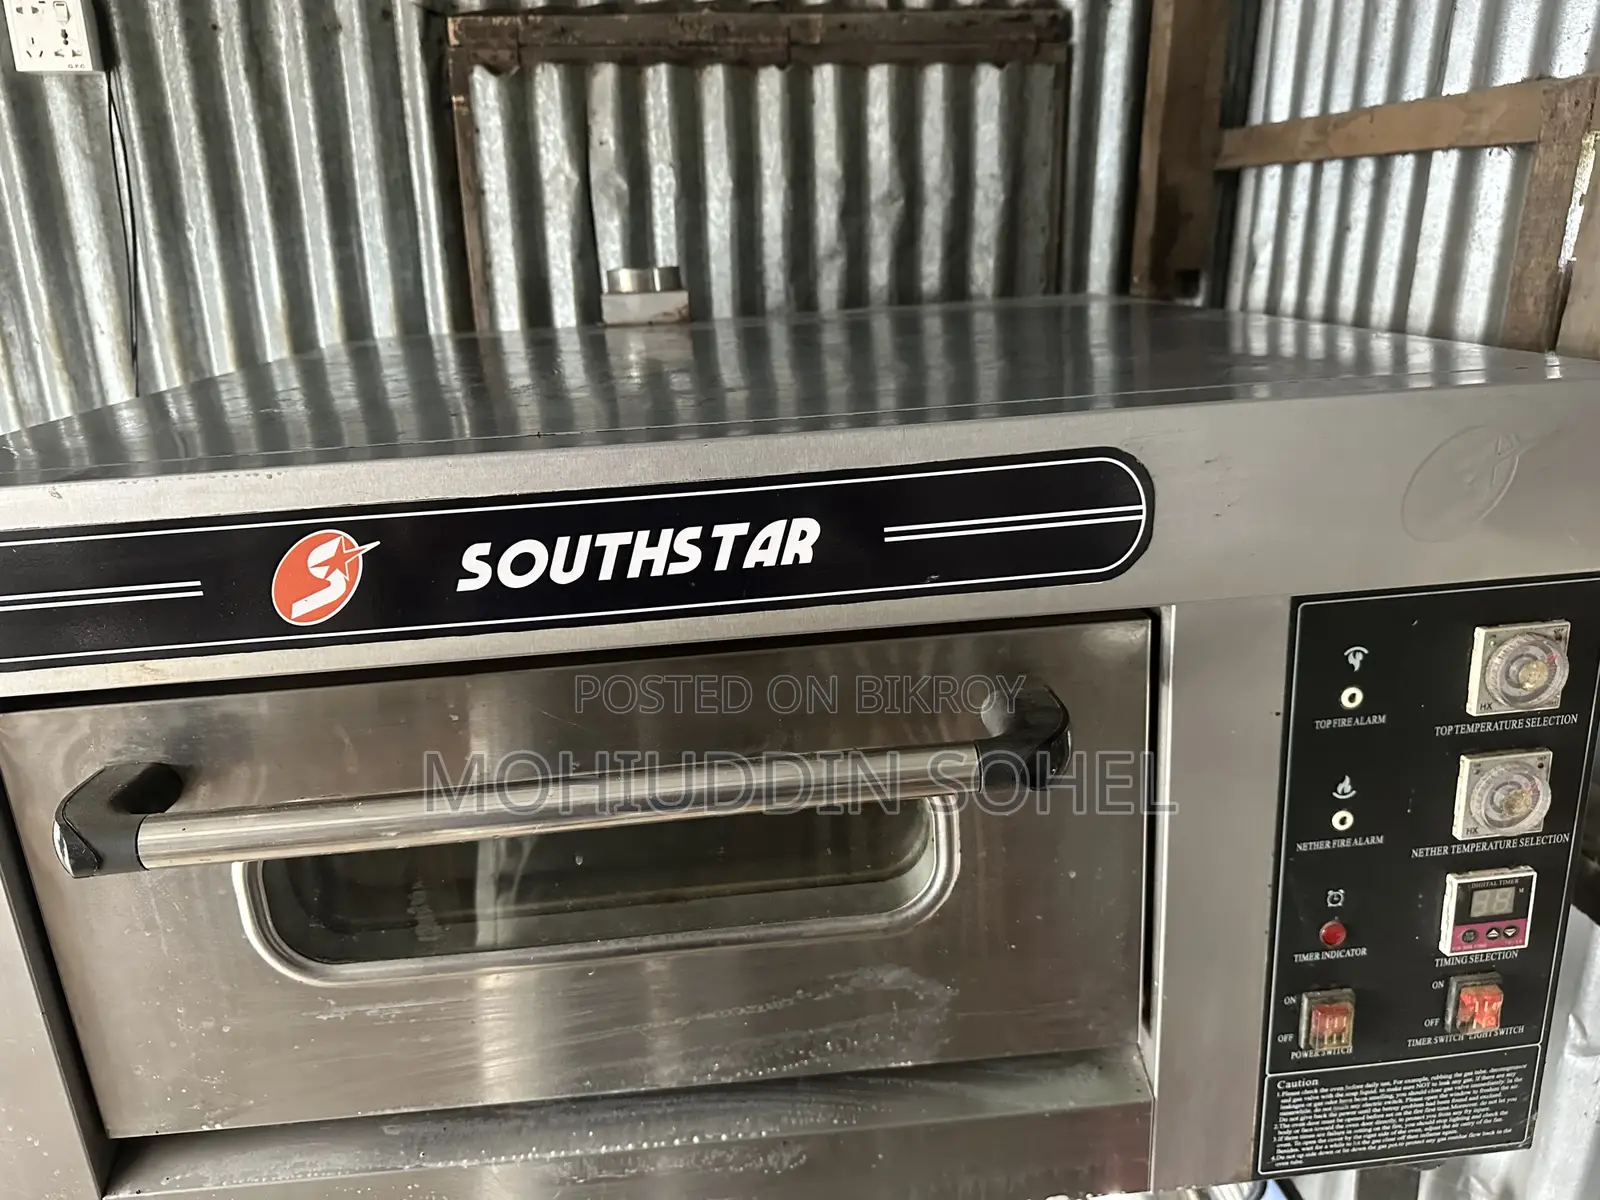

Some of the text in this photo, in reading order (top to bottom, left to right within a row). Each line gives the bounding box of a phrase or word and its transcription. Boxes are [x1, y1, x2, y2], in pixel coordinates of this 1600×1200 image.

[456, 517, 821, 592] SOUTHSTAR
[1480, 702, 1493, 710] HX
[1314, 714, 1386, 730] TOP FIRE ALARM
[1434, 714, 1578, 736] TOP TEMPERATURE SELECTION
[1296, 834, 1384, 852] NETHER FIRE ALARM
[1411, 832, 1570, 858] NETHER TEMPERATURE SELECTION
[1294, 948, 1367, 962] TIMER INDICATOR
[1434, 950, 1520, 968] TIMING SELECTION
[1432, 980, 1444, 990] ON
[1284, 996, 1297, 1004] ON
[1424, 1018, 1440, 1027] OFF
[1494, 1025, 1525, 1036] SWITCH
[1277, 1034, 1294, 1042] OFF
[1407, 1032, 1464, 1048] TIMER SWITCH
[1277, 1078, 1319, 1089] Caution
